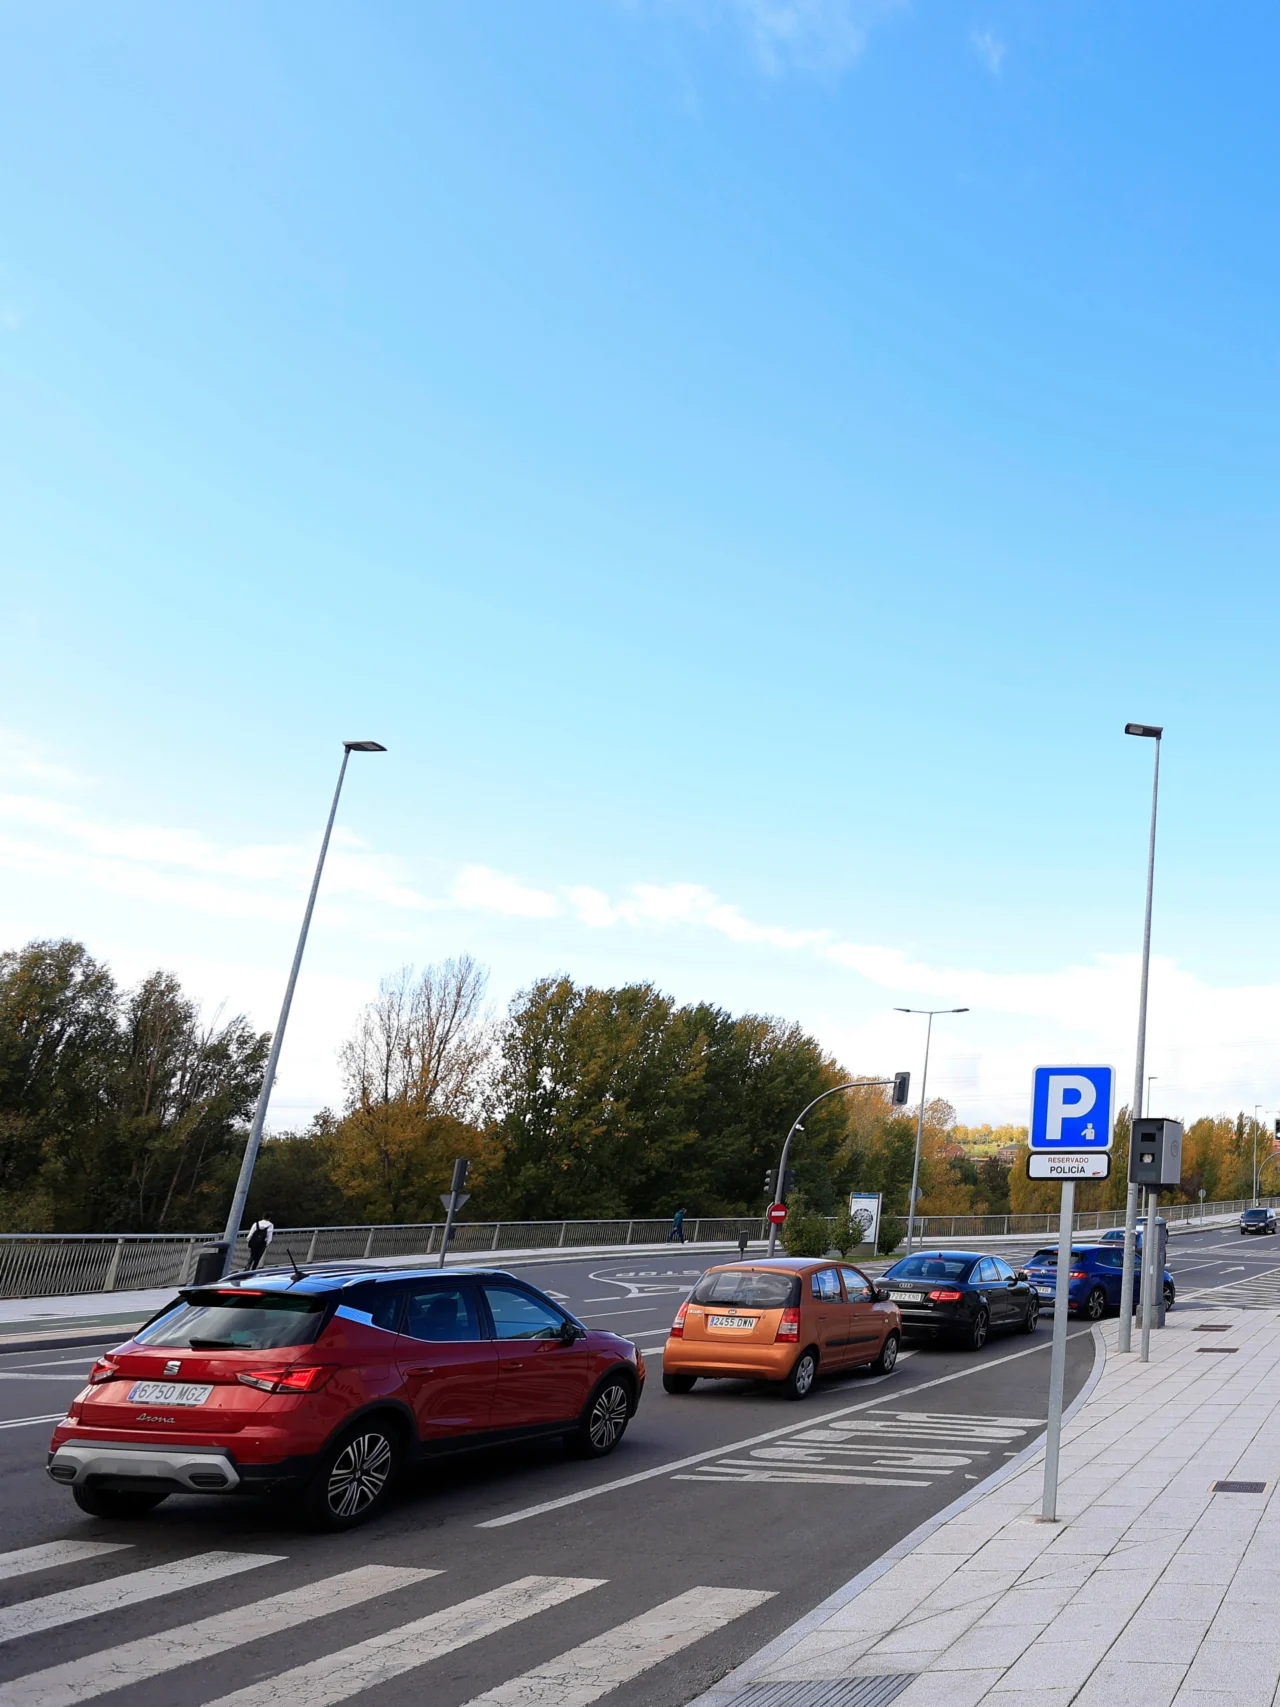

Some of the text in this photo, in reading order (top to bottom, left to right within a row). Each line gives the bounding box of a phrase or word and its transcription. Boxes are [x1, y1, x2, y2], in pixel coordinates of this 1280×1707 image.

[1045, 1075, 1097, 1140] P
[1049, 1163, 1086, 1174] POLICÍA
[714, 1317, 754, 1328] 2455 DWN
[138, 1384, 208, 1402] 6750 MGZ
[136, 1412, 176, 1424] Arona
